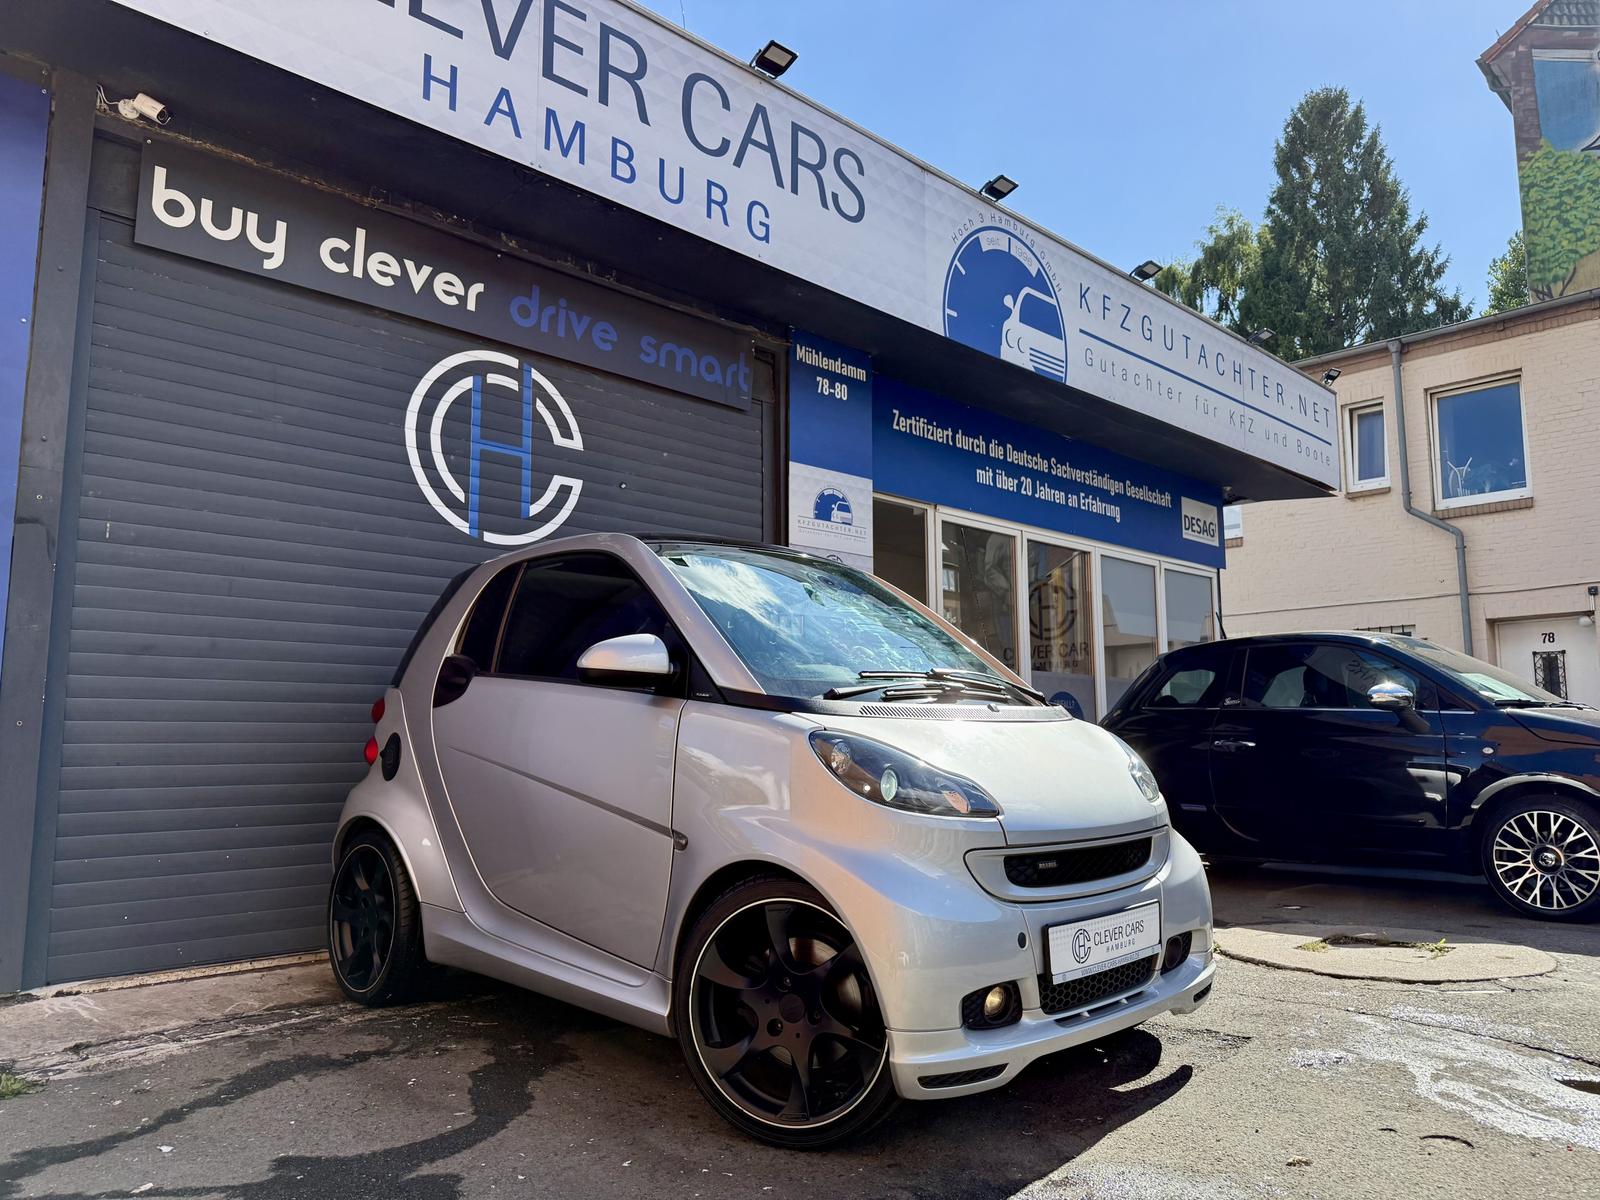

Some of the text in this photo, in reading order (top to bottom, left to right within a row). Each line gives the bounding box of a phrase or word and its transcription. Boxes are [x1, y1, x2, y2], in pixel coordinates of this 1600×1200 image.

[422, 53, 771, 244] HAMBURG
[681, 72, 867, 224] CARS
[152, 165, 750, 394] buy clever drive smart
[952, 212, 1063, 293] Hoch 3 Hamburg GmbH
[796, 343, 867, 382] Mühlendamm
[816, 376, 848, 400] 78-80
[1079, 282, 1330, 428] KFZGUTACHTER.NET
[1084, 347, 1331, 467] Gutachter für KFZ und Boote
[892, 409, 1172, 509] Zertifiziert durch die Deutsche Sachverständigen Gesellschaft
[976, 466, 1121, 524] mit über 20 Jahren an Erfahrung
[1184, 514, 1215, 538] DESAG
[1541, 632, 1555, 643] 78
[1093, 925, 1123, 946] CLEVER
[1125, 919, 1144, 936] CARS
[1106, 938, 1136, 953] HAMBURG
